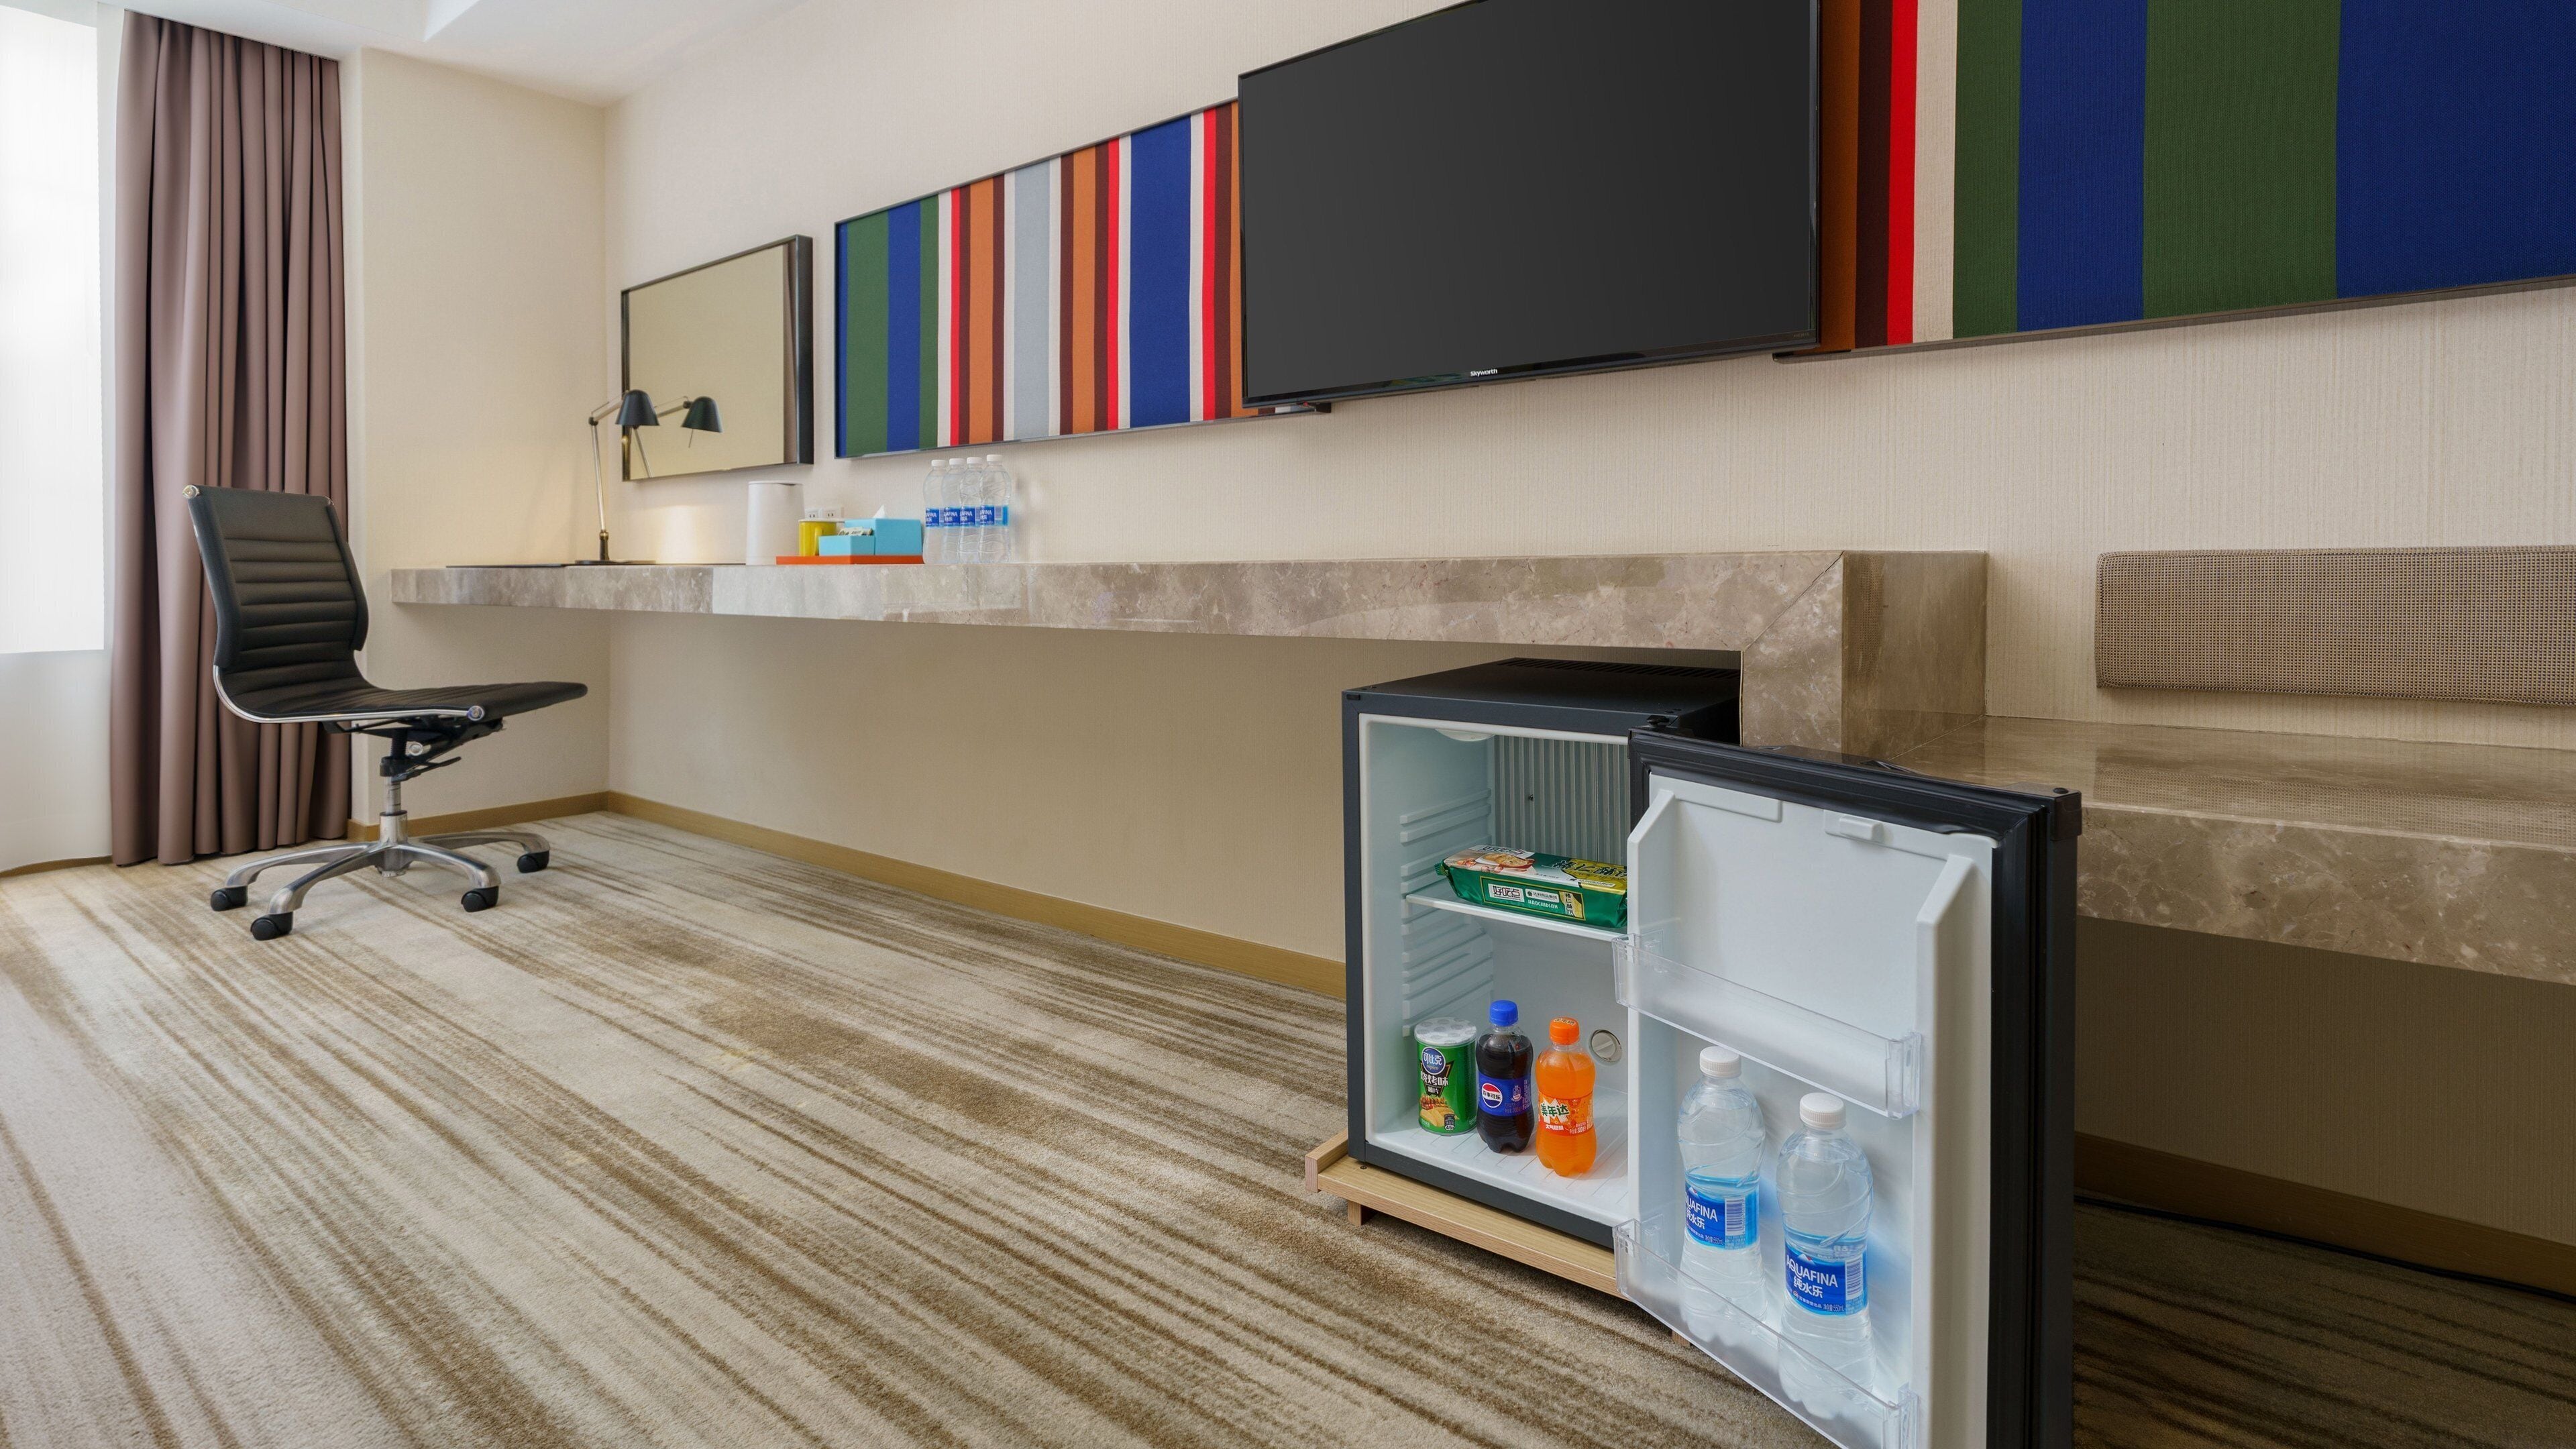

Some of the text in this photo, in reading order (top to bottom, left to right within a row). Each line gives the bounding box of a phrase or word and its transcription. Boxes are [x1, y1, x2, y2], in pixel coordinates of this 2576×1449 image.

[1470, 368, 1498, 377] Skyworth
[1493, 885, 1521, 898] 好吃点
[1424, 1051, 1442, 1065] 可比克
[1421, 1071, 1448, 1086] 烧烤味
[1541, 1103, 1569, 1116] 美年达
[1786, 1254, 1838, 1287] AQUAFINA
[1794, 1276, 1823, 1298] 纯水乐
